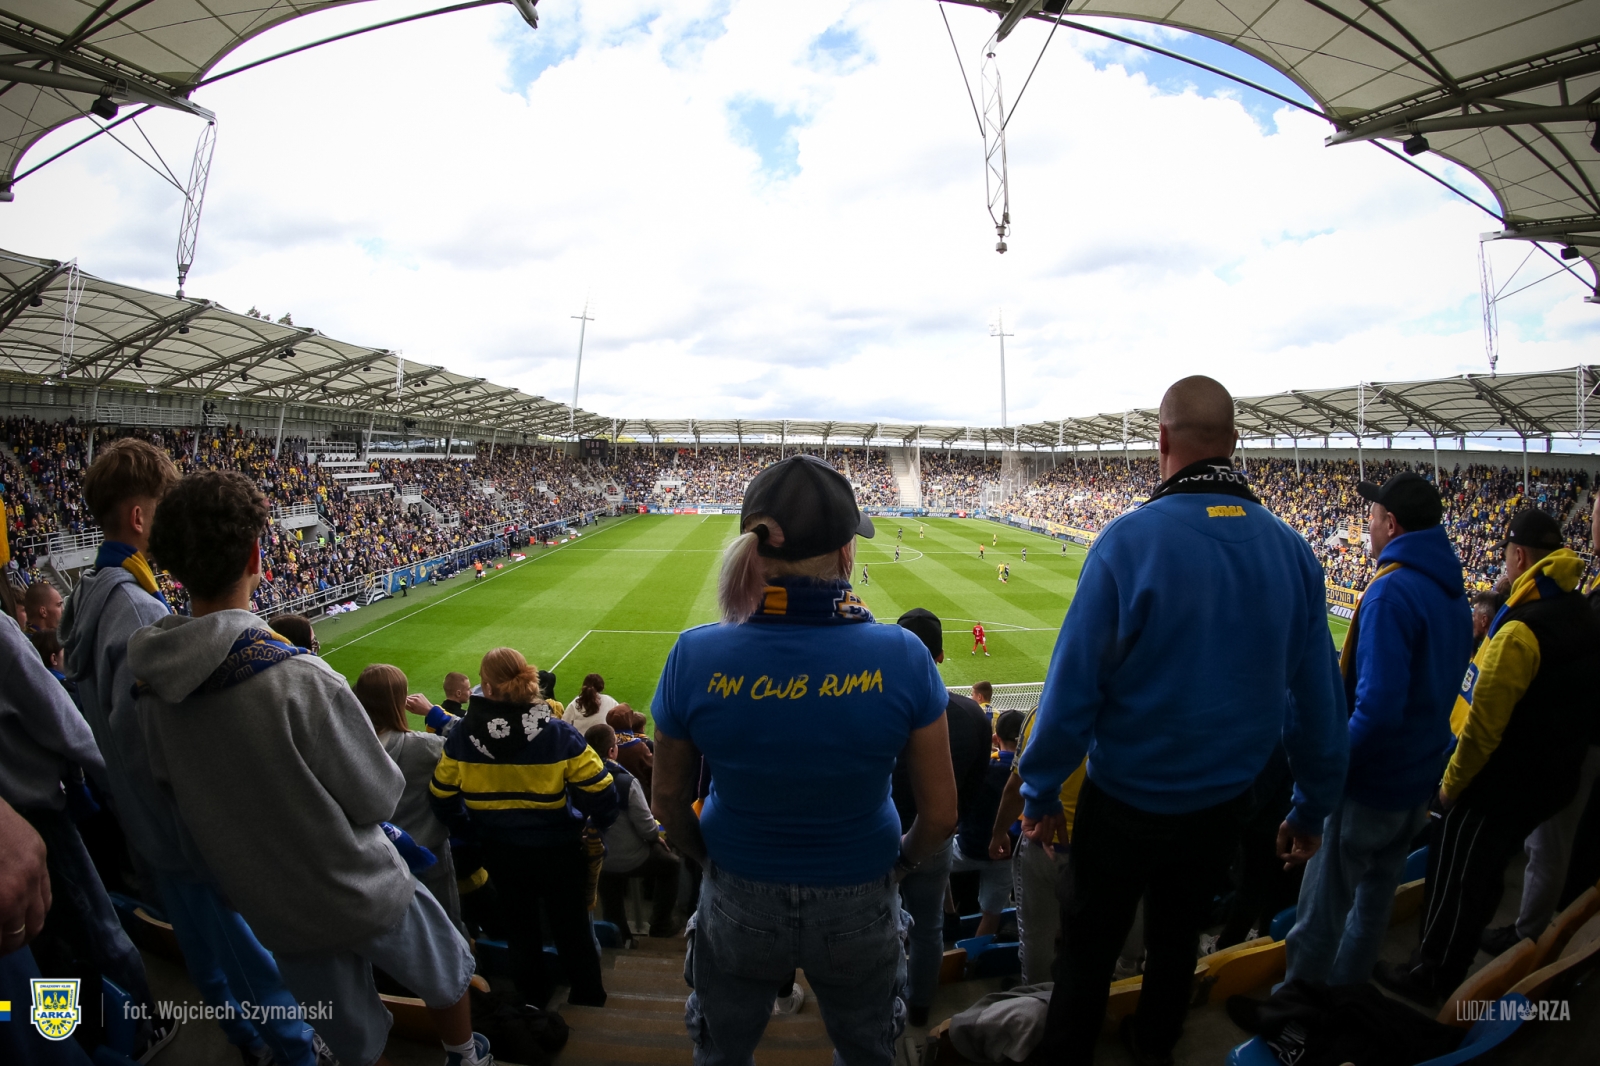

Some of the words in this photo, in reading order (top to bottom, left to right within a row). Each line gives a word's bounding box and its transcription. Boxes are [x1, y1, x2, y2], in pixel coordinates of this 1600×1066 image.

[1326, 589, 1351, 603] GDYNIA
[708, 672, 744, 698] FAN
[751, 674, 809, 699] CLUB
[818, 668, 883, 697] RUMIA
